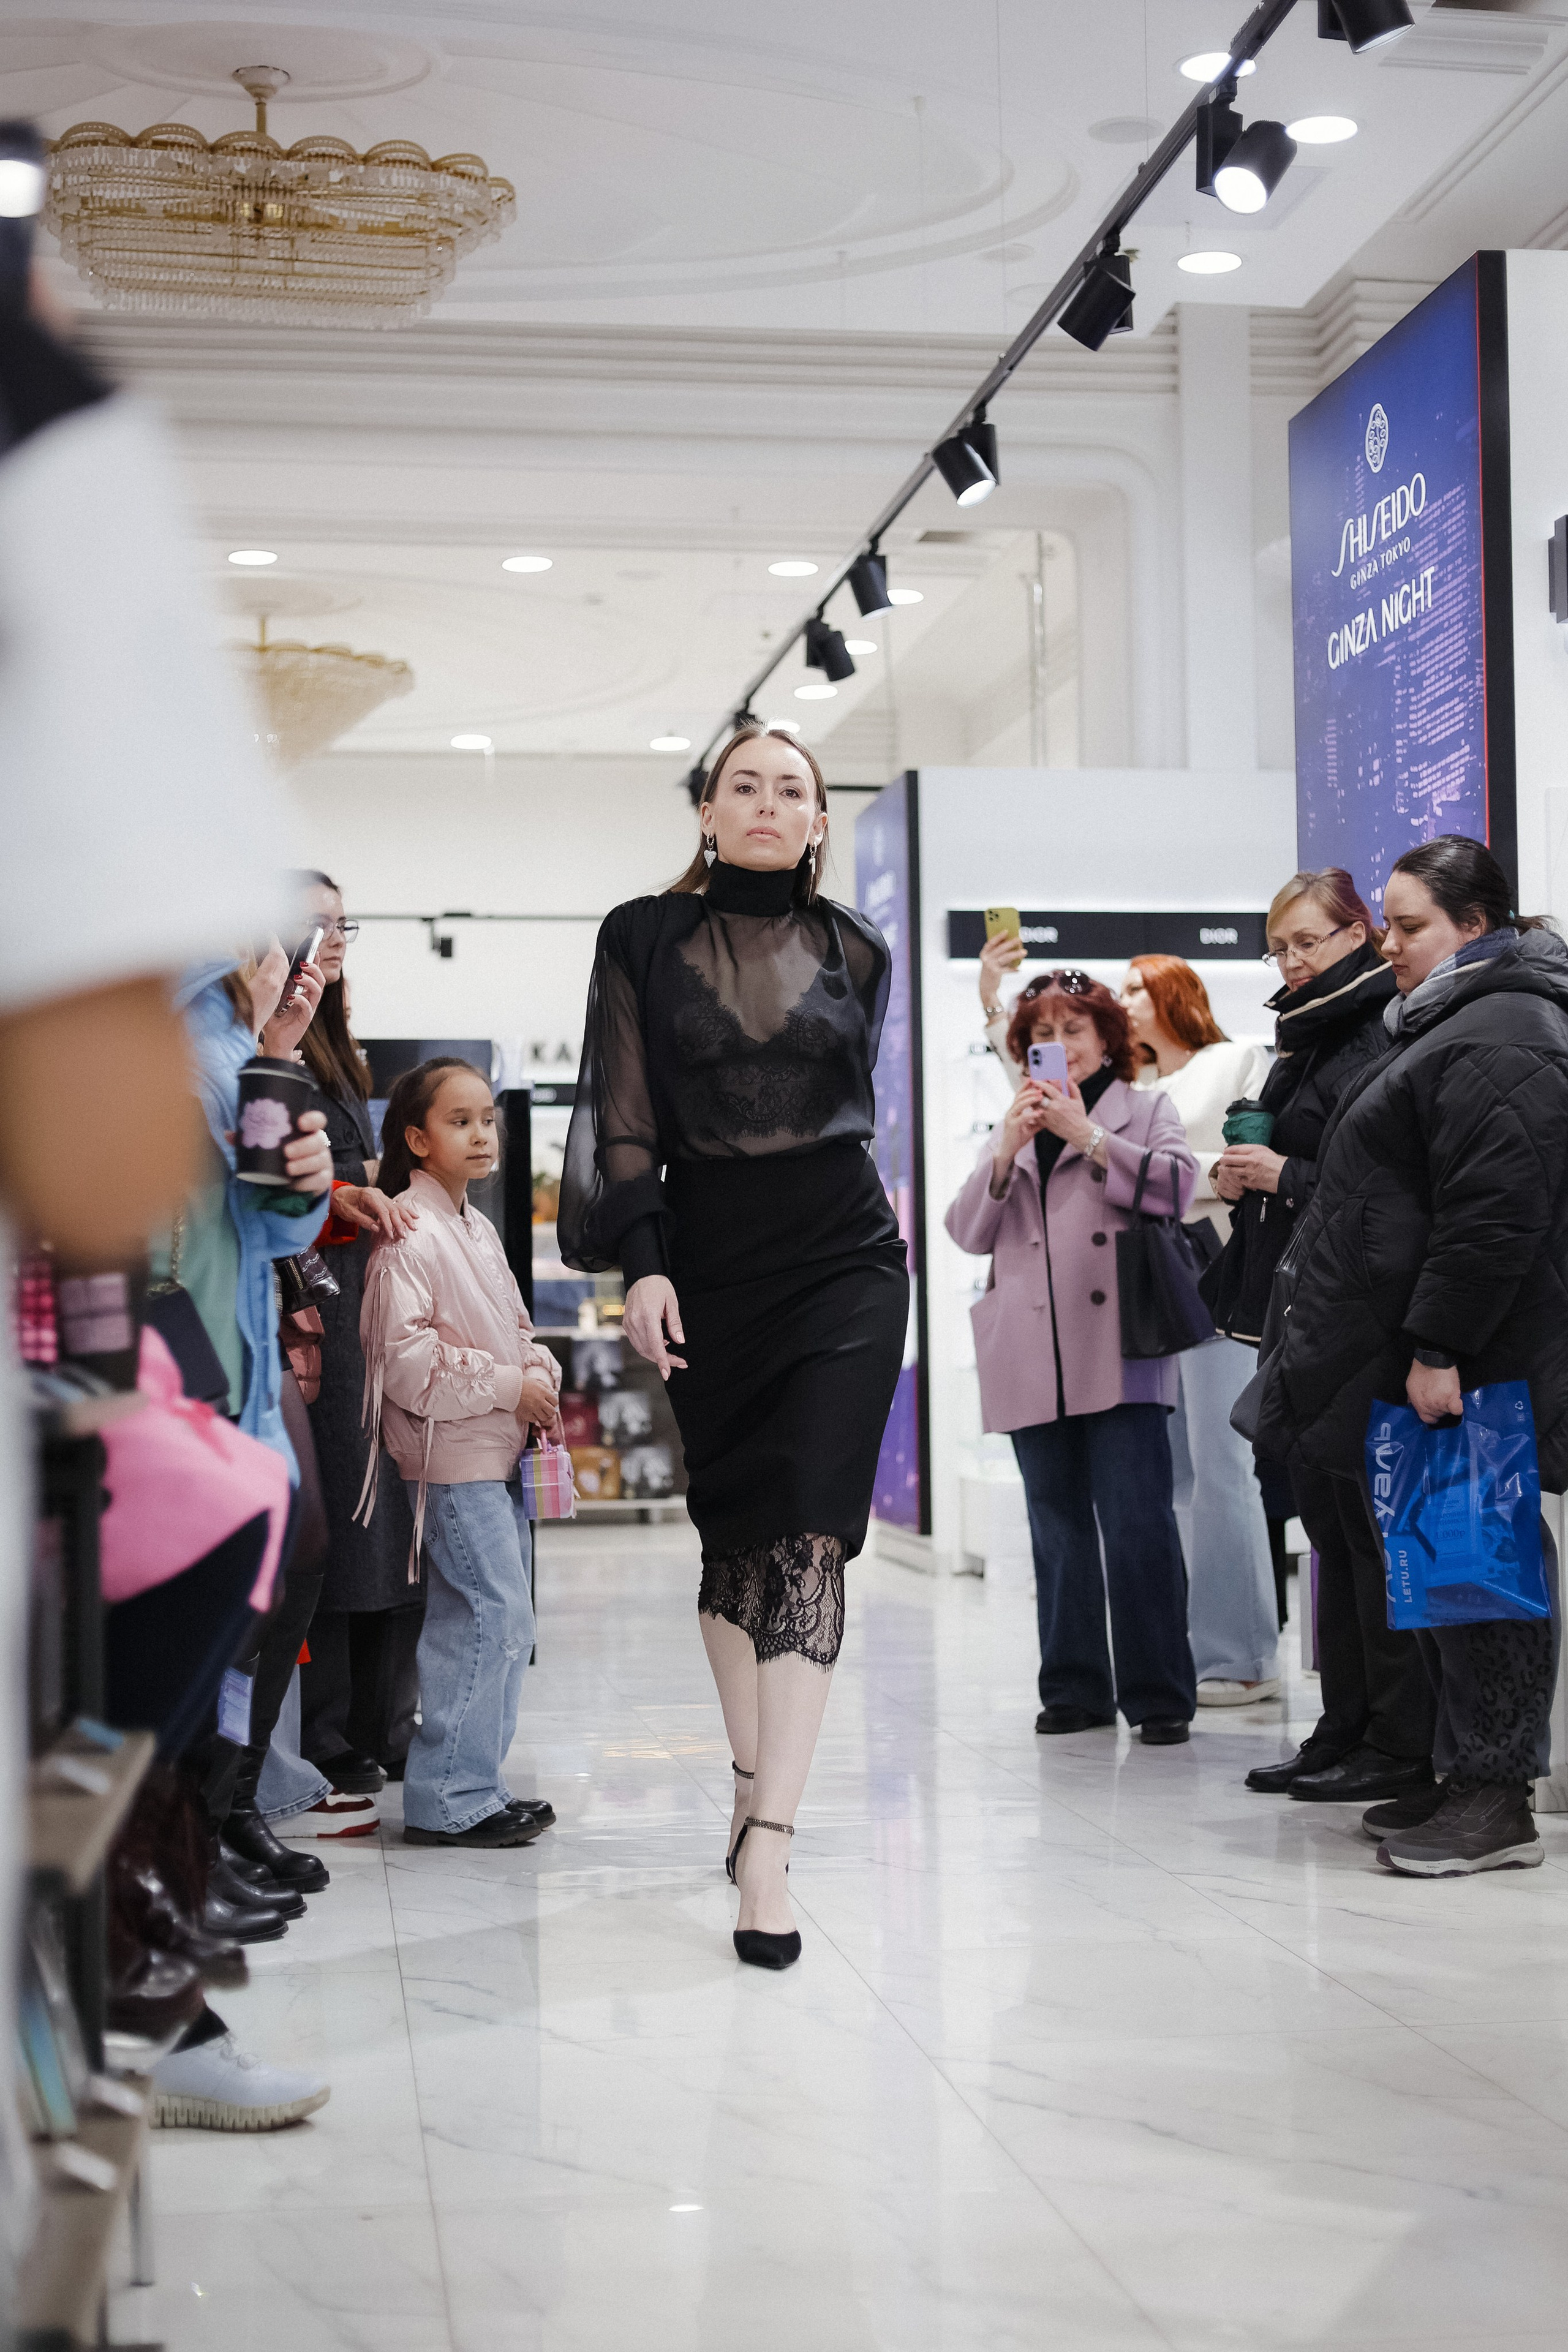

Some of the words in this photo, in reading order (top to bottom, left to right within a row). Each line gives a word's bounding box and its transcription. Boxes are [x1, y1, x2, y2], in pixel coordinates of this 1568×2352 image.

[1331, 472, 1426, 577] SHISEIDO
[1350, 560, 1379, 590] GINZA
[1381, 537, 1411, 569] TOKYO
[1327, 608, 1378, 670] GINZA
[1381, 567, 1434, 638] NIGHT
[1398, 1550, 1412, 1603] LETU.RU
